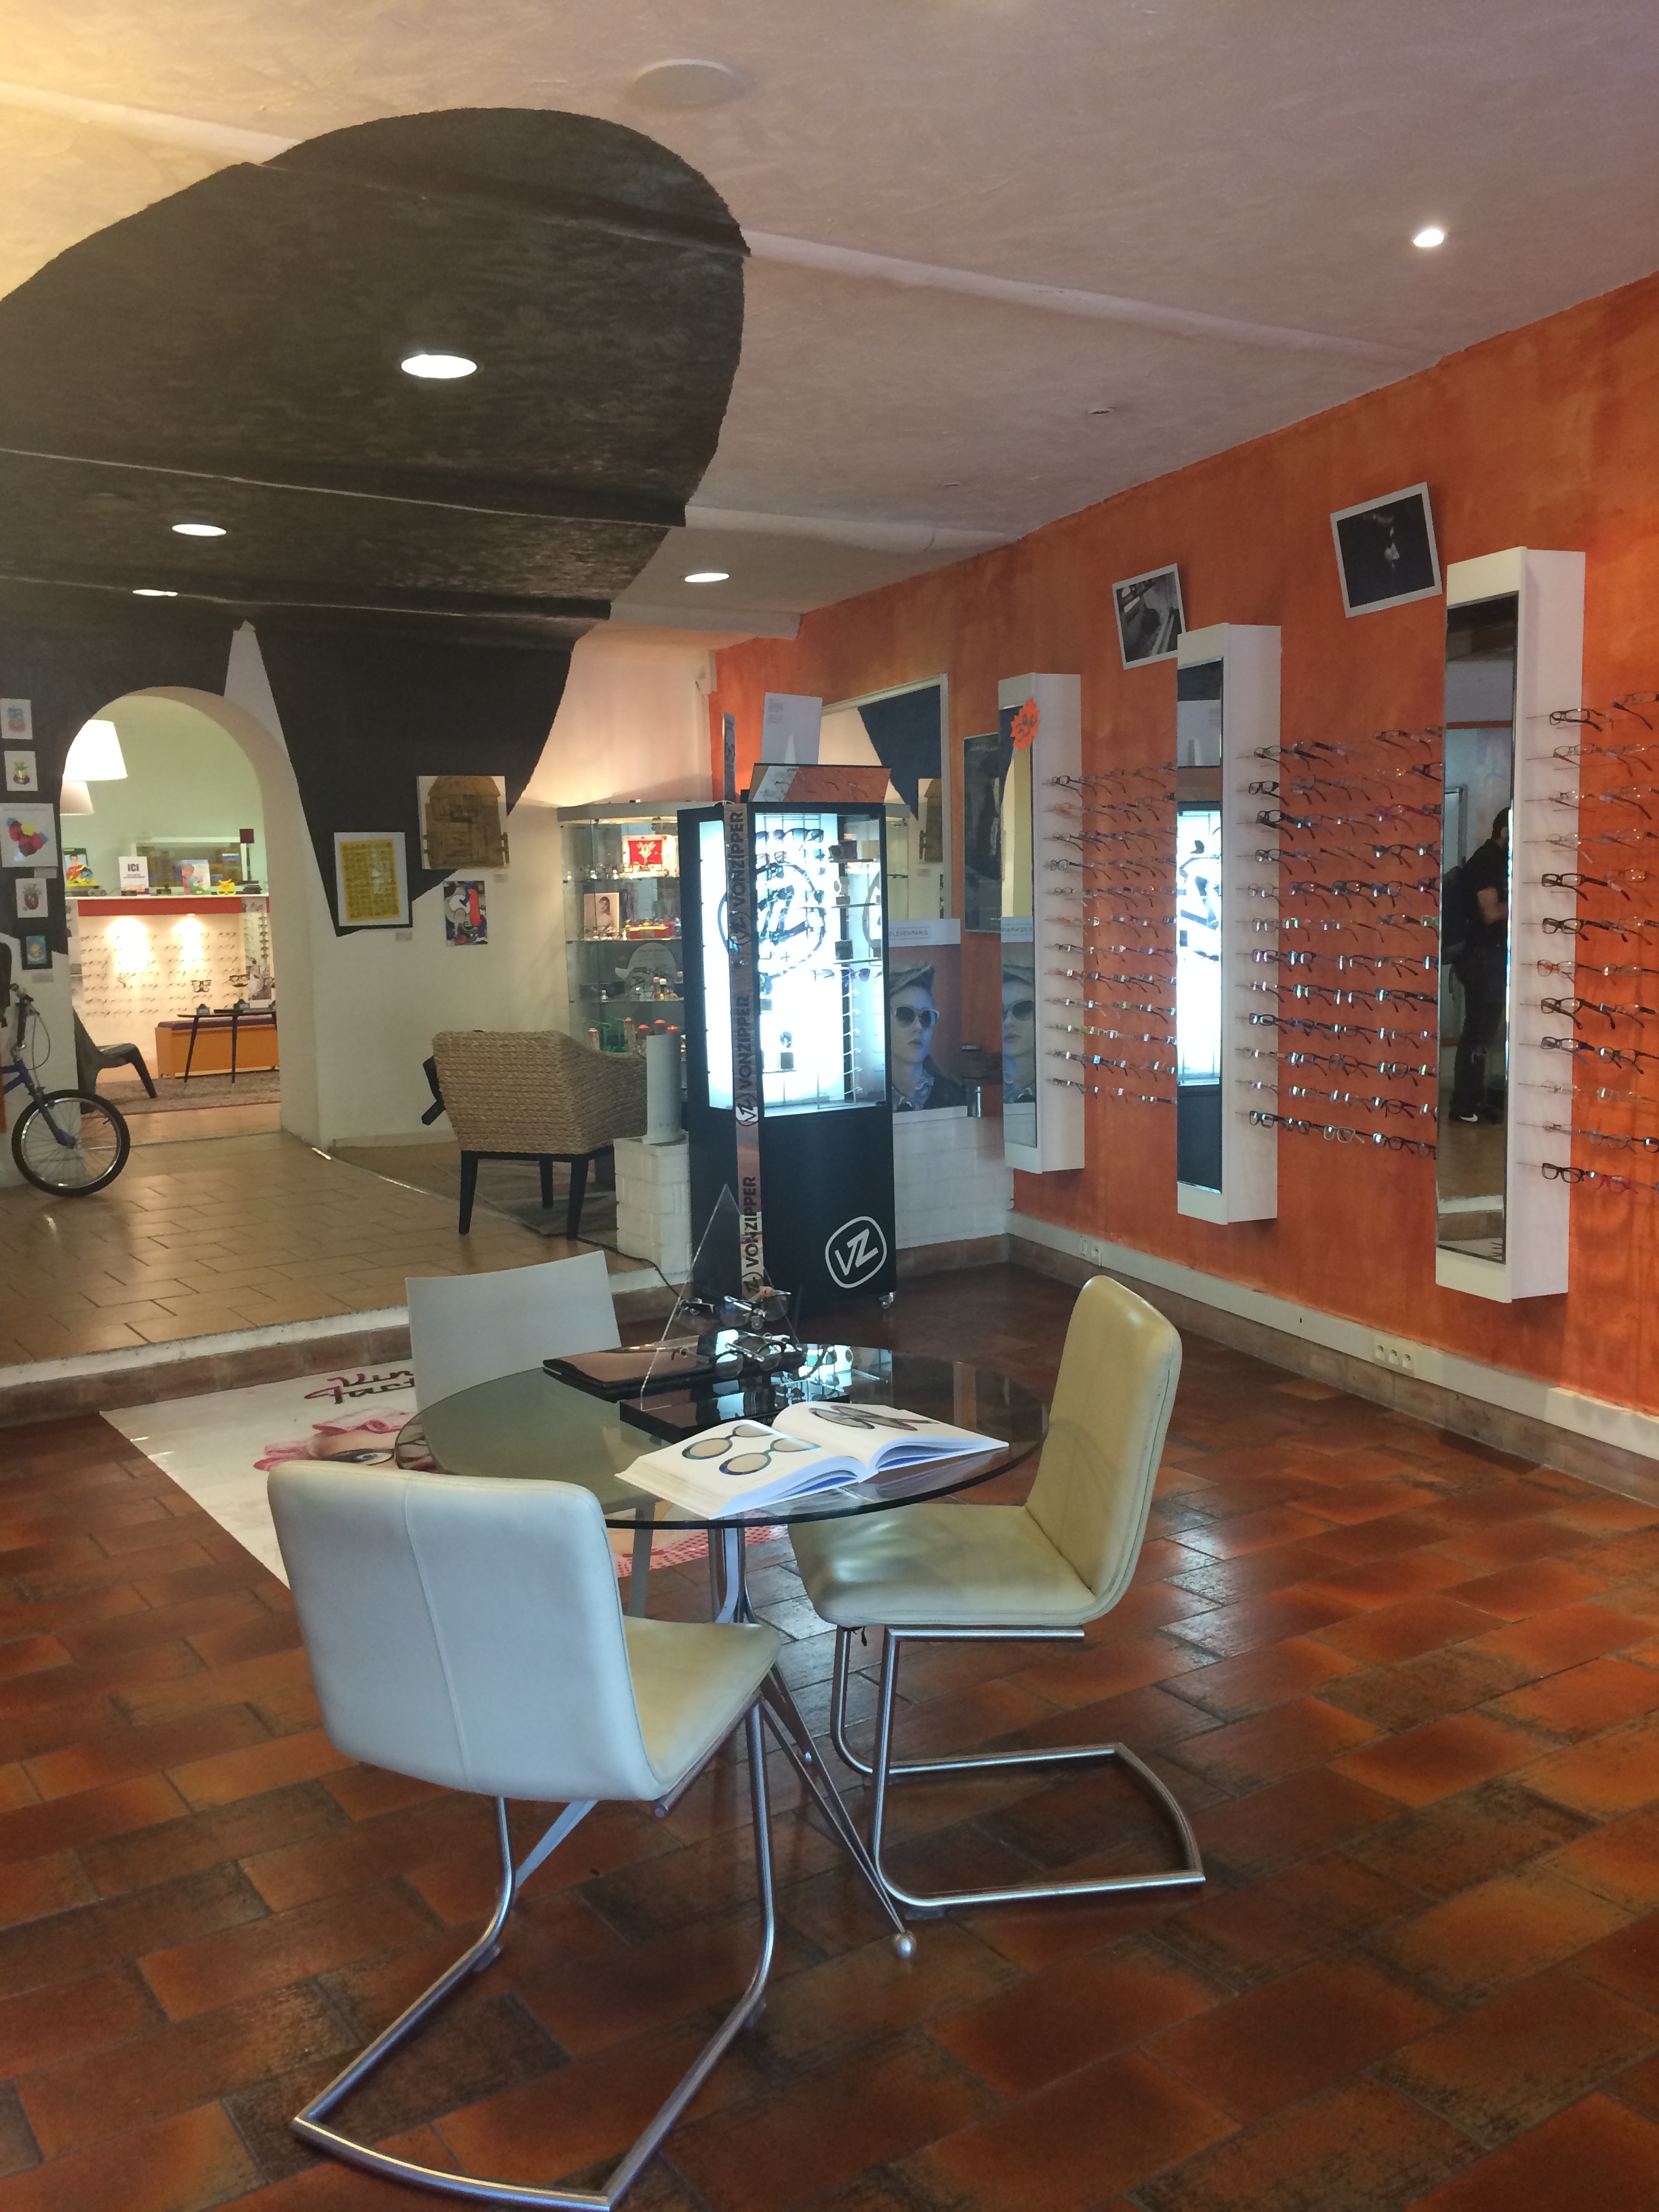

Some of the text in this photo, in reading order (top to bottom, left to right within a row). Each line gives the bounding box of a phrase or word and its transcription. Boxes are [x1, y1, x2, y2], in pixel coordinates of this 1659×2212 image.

[127, 863, 140, 872] ICI
[729, 811, 745, 907] VONZIPPER
[735, 995, 752, 1090] VONZIPPER
[743, 1176, 759, 1268] VONZIPPER
[834, 1227, 879, 1276] VZ
